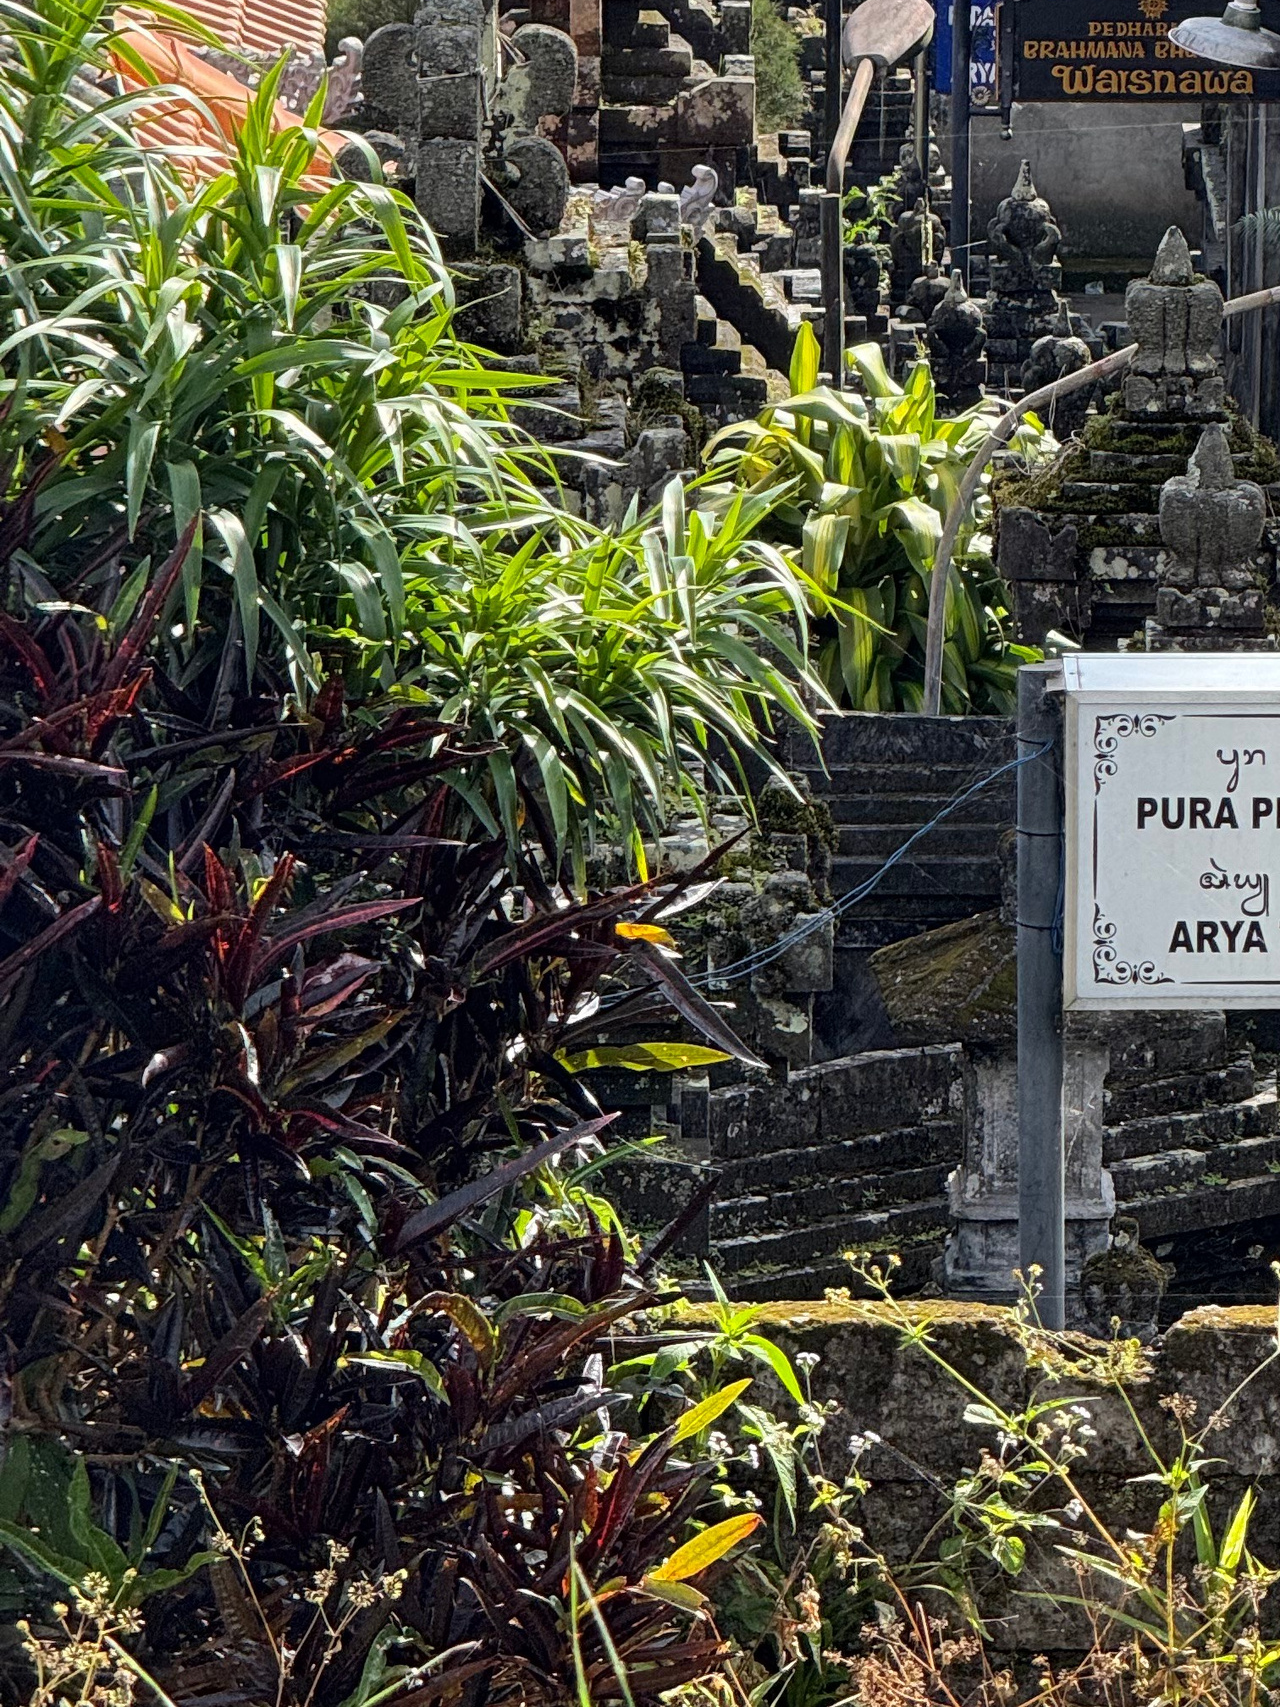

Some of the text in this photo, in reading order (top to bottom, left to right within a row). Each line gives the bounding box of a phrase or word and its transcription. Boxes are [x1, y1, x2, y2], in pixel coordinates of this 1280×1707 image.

[1088, 21, 1175, 37] PEDHAR
[1023, 40, 1145, 59] BRAHMANA
[1051, 64, 1254, 95] Waisnawa
[1136, 797, 1239, 829] PURA
[1168, 921, 1268, 953] ARYA
